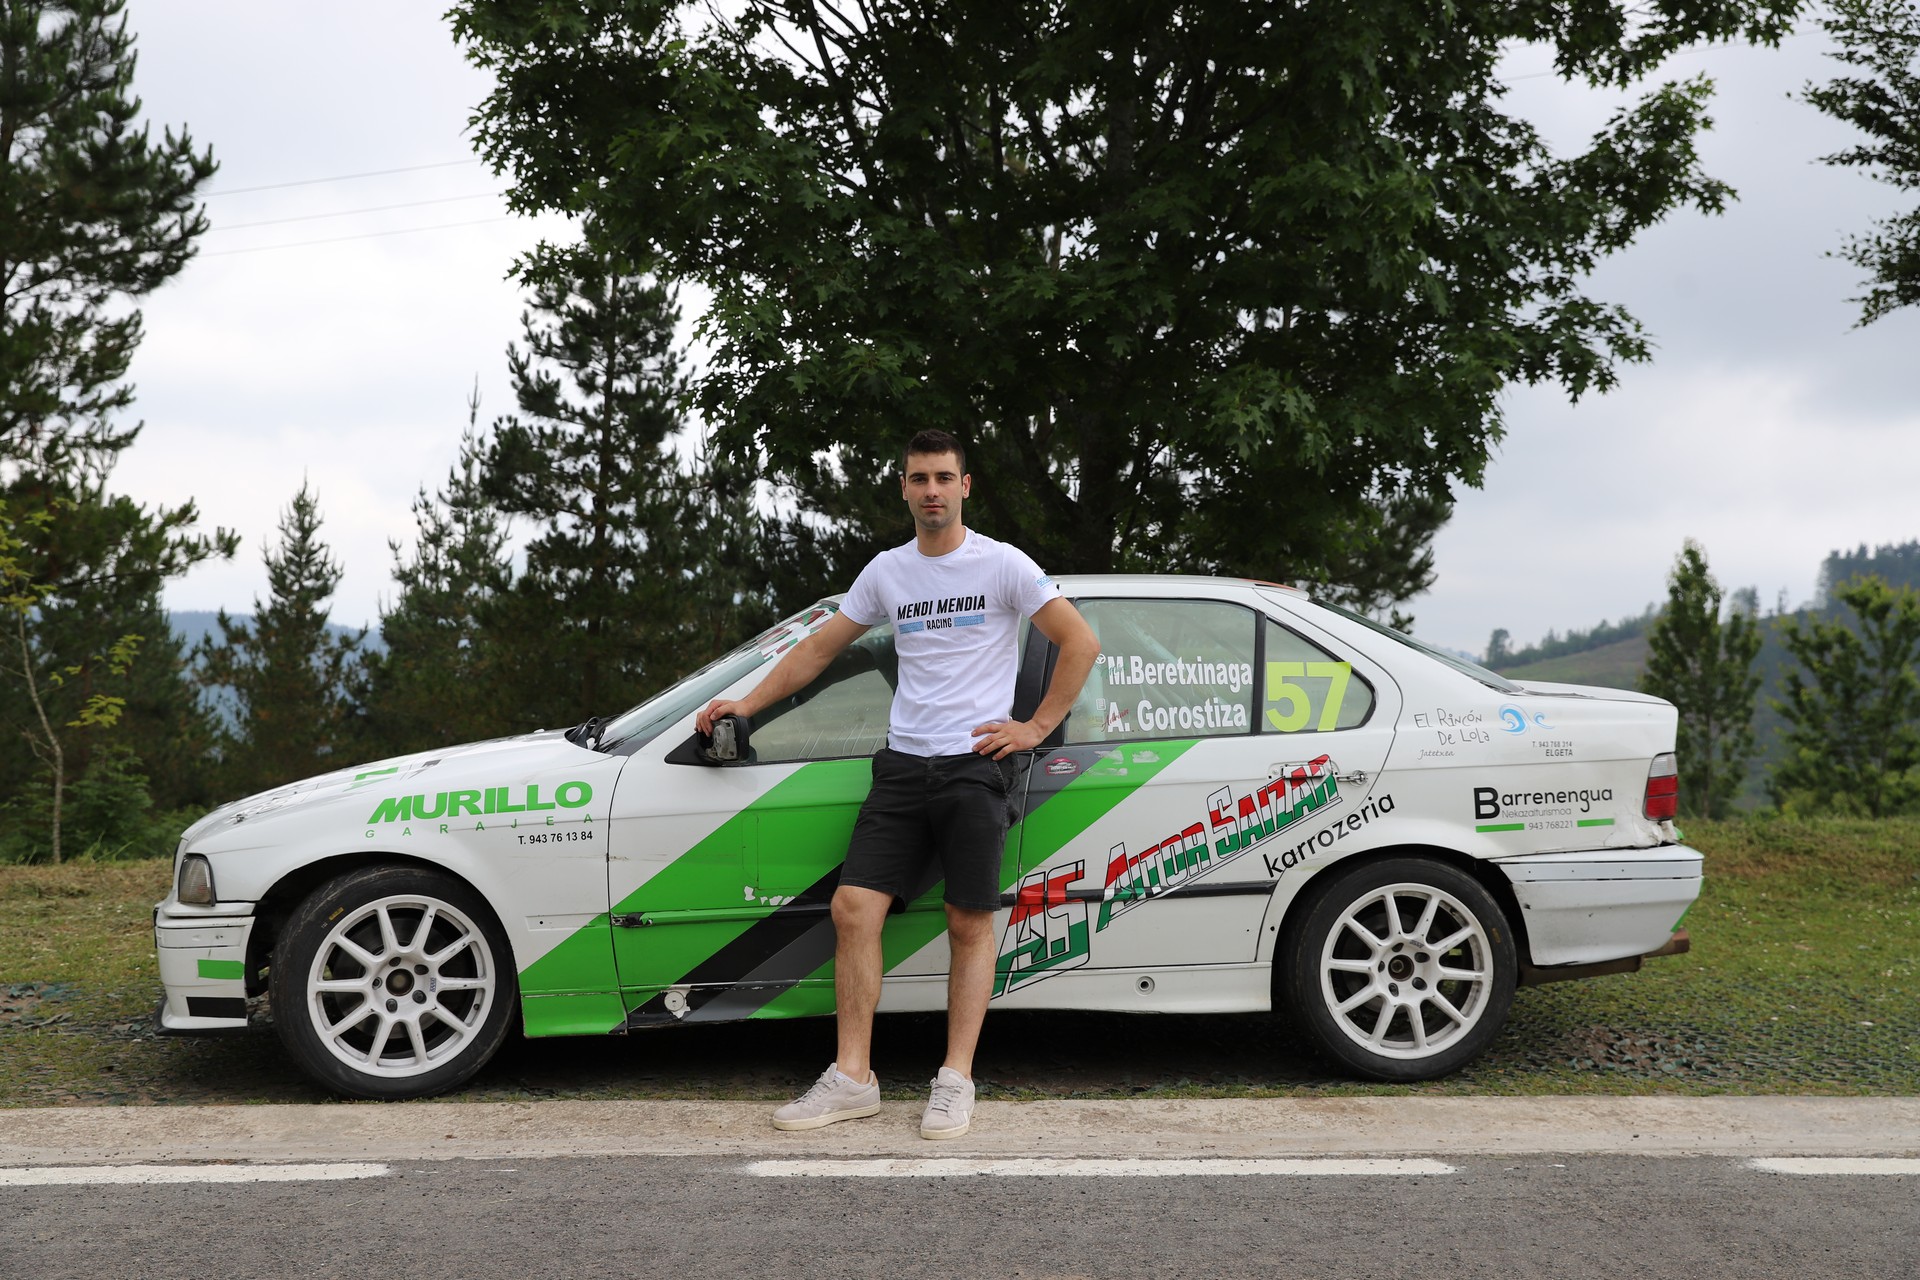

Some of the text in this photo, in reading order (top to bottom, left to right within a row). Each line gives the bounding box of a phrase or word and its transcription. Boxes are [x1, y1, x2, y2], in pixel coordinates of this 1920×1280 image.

[897, 595, 985, 620] MENDI MENDIA
[926, 617, 952, 630] RACING
[1107, 656, 1253, 693] M.Beretxinaga
[1265, 661, 1351, 733] 57
[1107, 697, 1247, 733] A. Gorostiza
[1545, 748, 1573, 757] ELGETA
[366, 780, 593, 825] MURILLO
[1473, 787, 1613, 820] Barrenengua
[517, 830, 593, 845] T. 943 76 13 84
[1263, 793, 1396, 878] karrozeria
[1528, 820, 1573, 831] 943 768221
